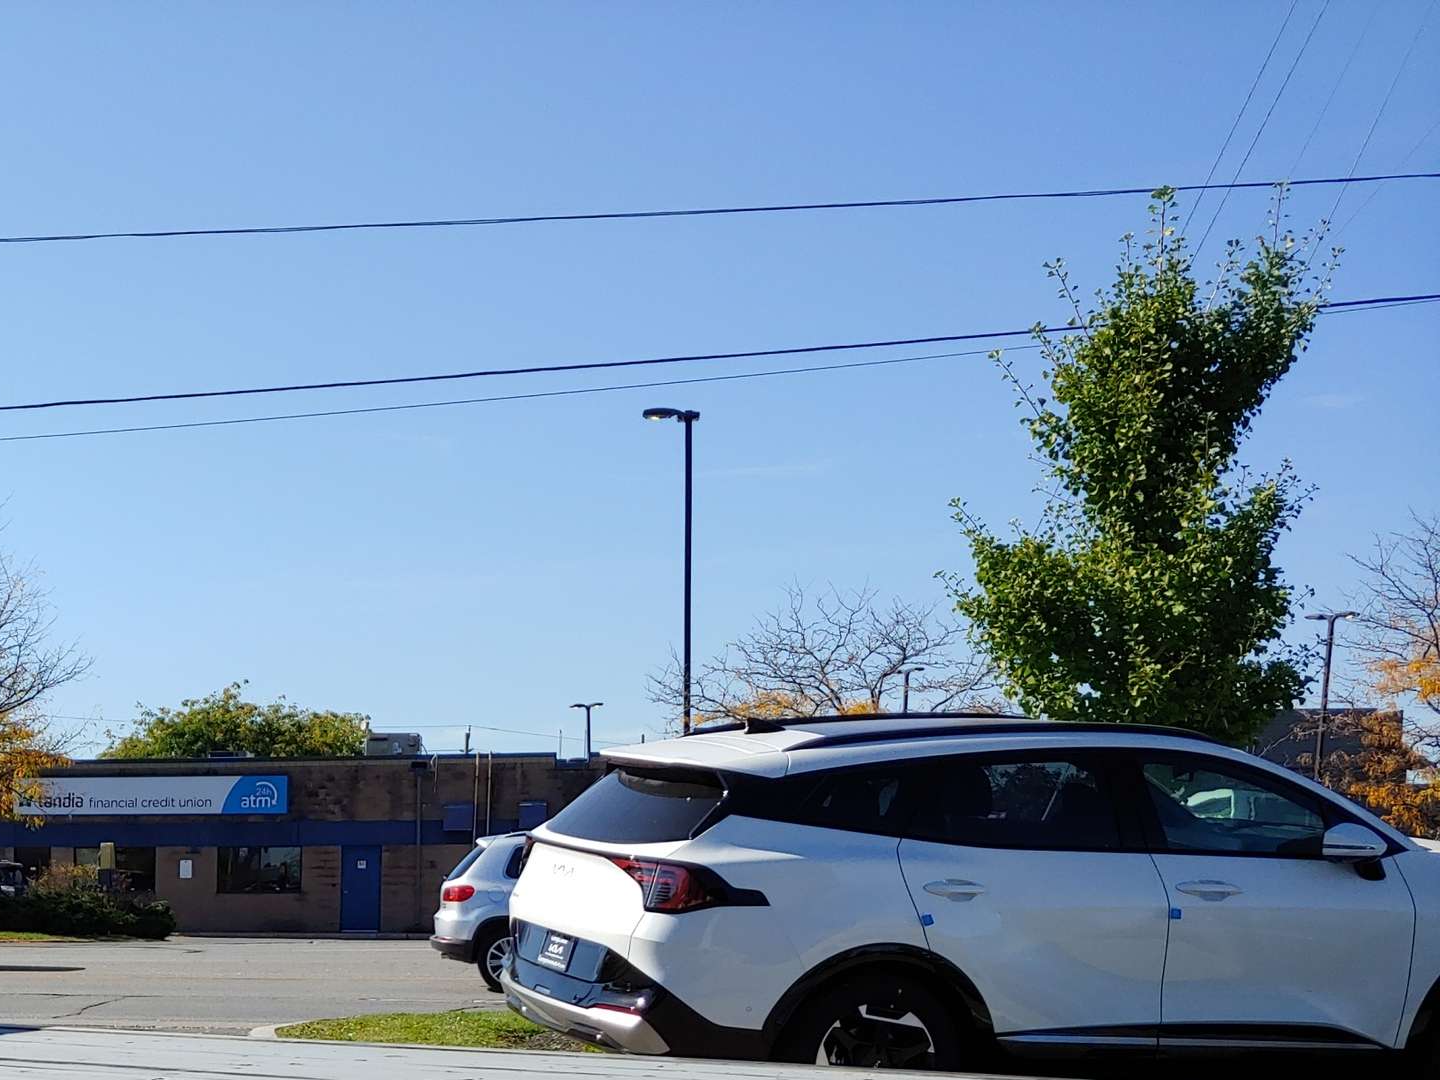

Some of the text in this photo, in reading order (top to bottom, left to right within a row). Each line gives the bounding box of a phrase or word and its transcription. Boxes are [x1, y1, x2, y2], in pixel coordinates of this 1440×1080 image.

[89, 797, 137, 808] financial
[141, 797, 175, 808] credit
[178, 798, 212, 808] union
[240, 794, 271, 808] atm
